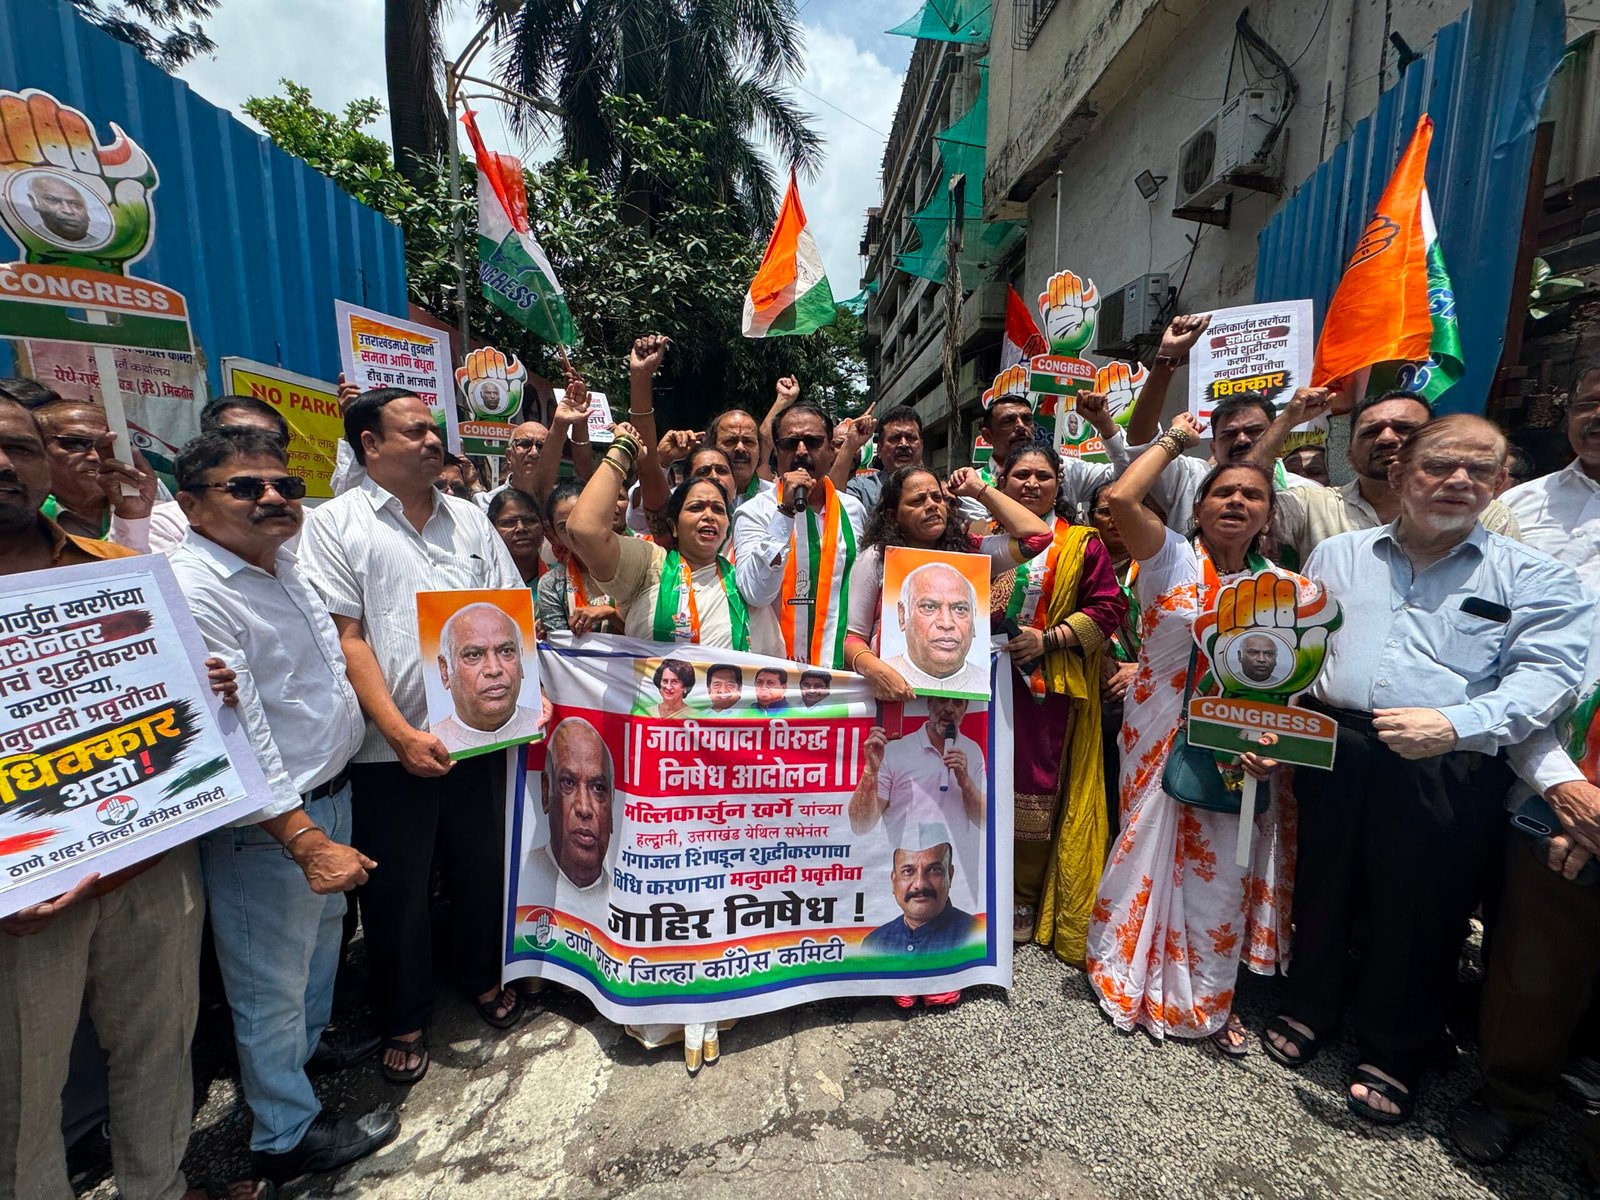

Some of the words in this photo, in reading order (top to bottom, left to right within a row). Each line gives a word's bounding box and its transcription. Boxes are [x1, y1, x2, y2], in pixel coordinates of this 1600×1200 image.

[0, 270, 170, 310] CONGRESS
[360, 350, 388, 365] समता
[390, 353, 412, 368] आणि
[1037, 358, 1092, 376] CONGRESS
[366, 368, 382, 382] हीच
[383, 373, 394, 383] का
[395, 372, 405, 385] ती
[407, 376, 437, 388] भाजपची
[1213, 372, 1285, 398] धिक्कार
[251, 382, 283, 405] NO
[289, 392, 343, 418] PARK
[463, 424, 513, 437] CONGRE
[1060, 446, 1079, 457] CONG
[60, 587, 146, 619] खरगेंच्या
[36, 638, 158, 688] शुद्धीकरण
[82, 682, 168, 723] प्रवृत्तीचा
[1201, 702, 1321, 733] CONGRESS
[0, 708, 181, 804] धिक्कार
[658, 758, 727, 791] निषेध
[732, 754, 828, 789] आंदोलन
[624, 800, 746, 824] मल्लिकार्जुन
[751, 798, 795, 818] खर्गे
[798, 803, 843, 817] यांच्या
[7, 854, 46, 878] ठाणे
[48, 838, 86, 861] शहर
[88, 822, 136, 849] जिल्हा
[183, 786, 226, 810] कमिटी
[687, 826, 740, 843] उत्तराखंड
[744, 824, 780, 839] येथिल
[784, 822, 829, 838] सभेनंतर
[622, 845, 681, 869] गंगाजल
[749, 841, 851, 865] शुद्धीकरणाचा
[613, 867, 643, 895] विधि
[729, 864, 797, 890] मनुवादी
[801, 864, 863, 886] प्रवृत्तीचा
[607, 902, 714, 943] जाहिर
[724, 890, 837, 935] निषेध
[564, 929, 593, 958] ठाणे
[595, 946, 623, 982] शहर
[629, 957, 695, 985] जिल्हा
[777, 935, 845, 966] कमिटी
